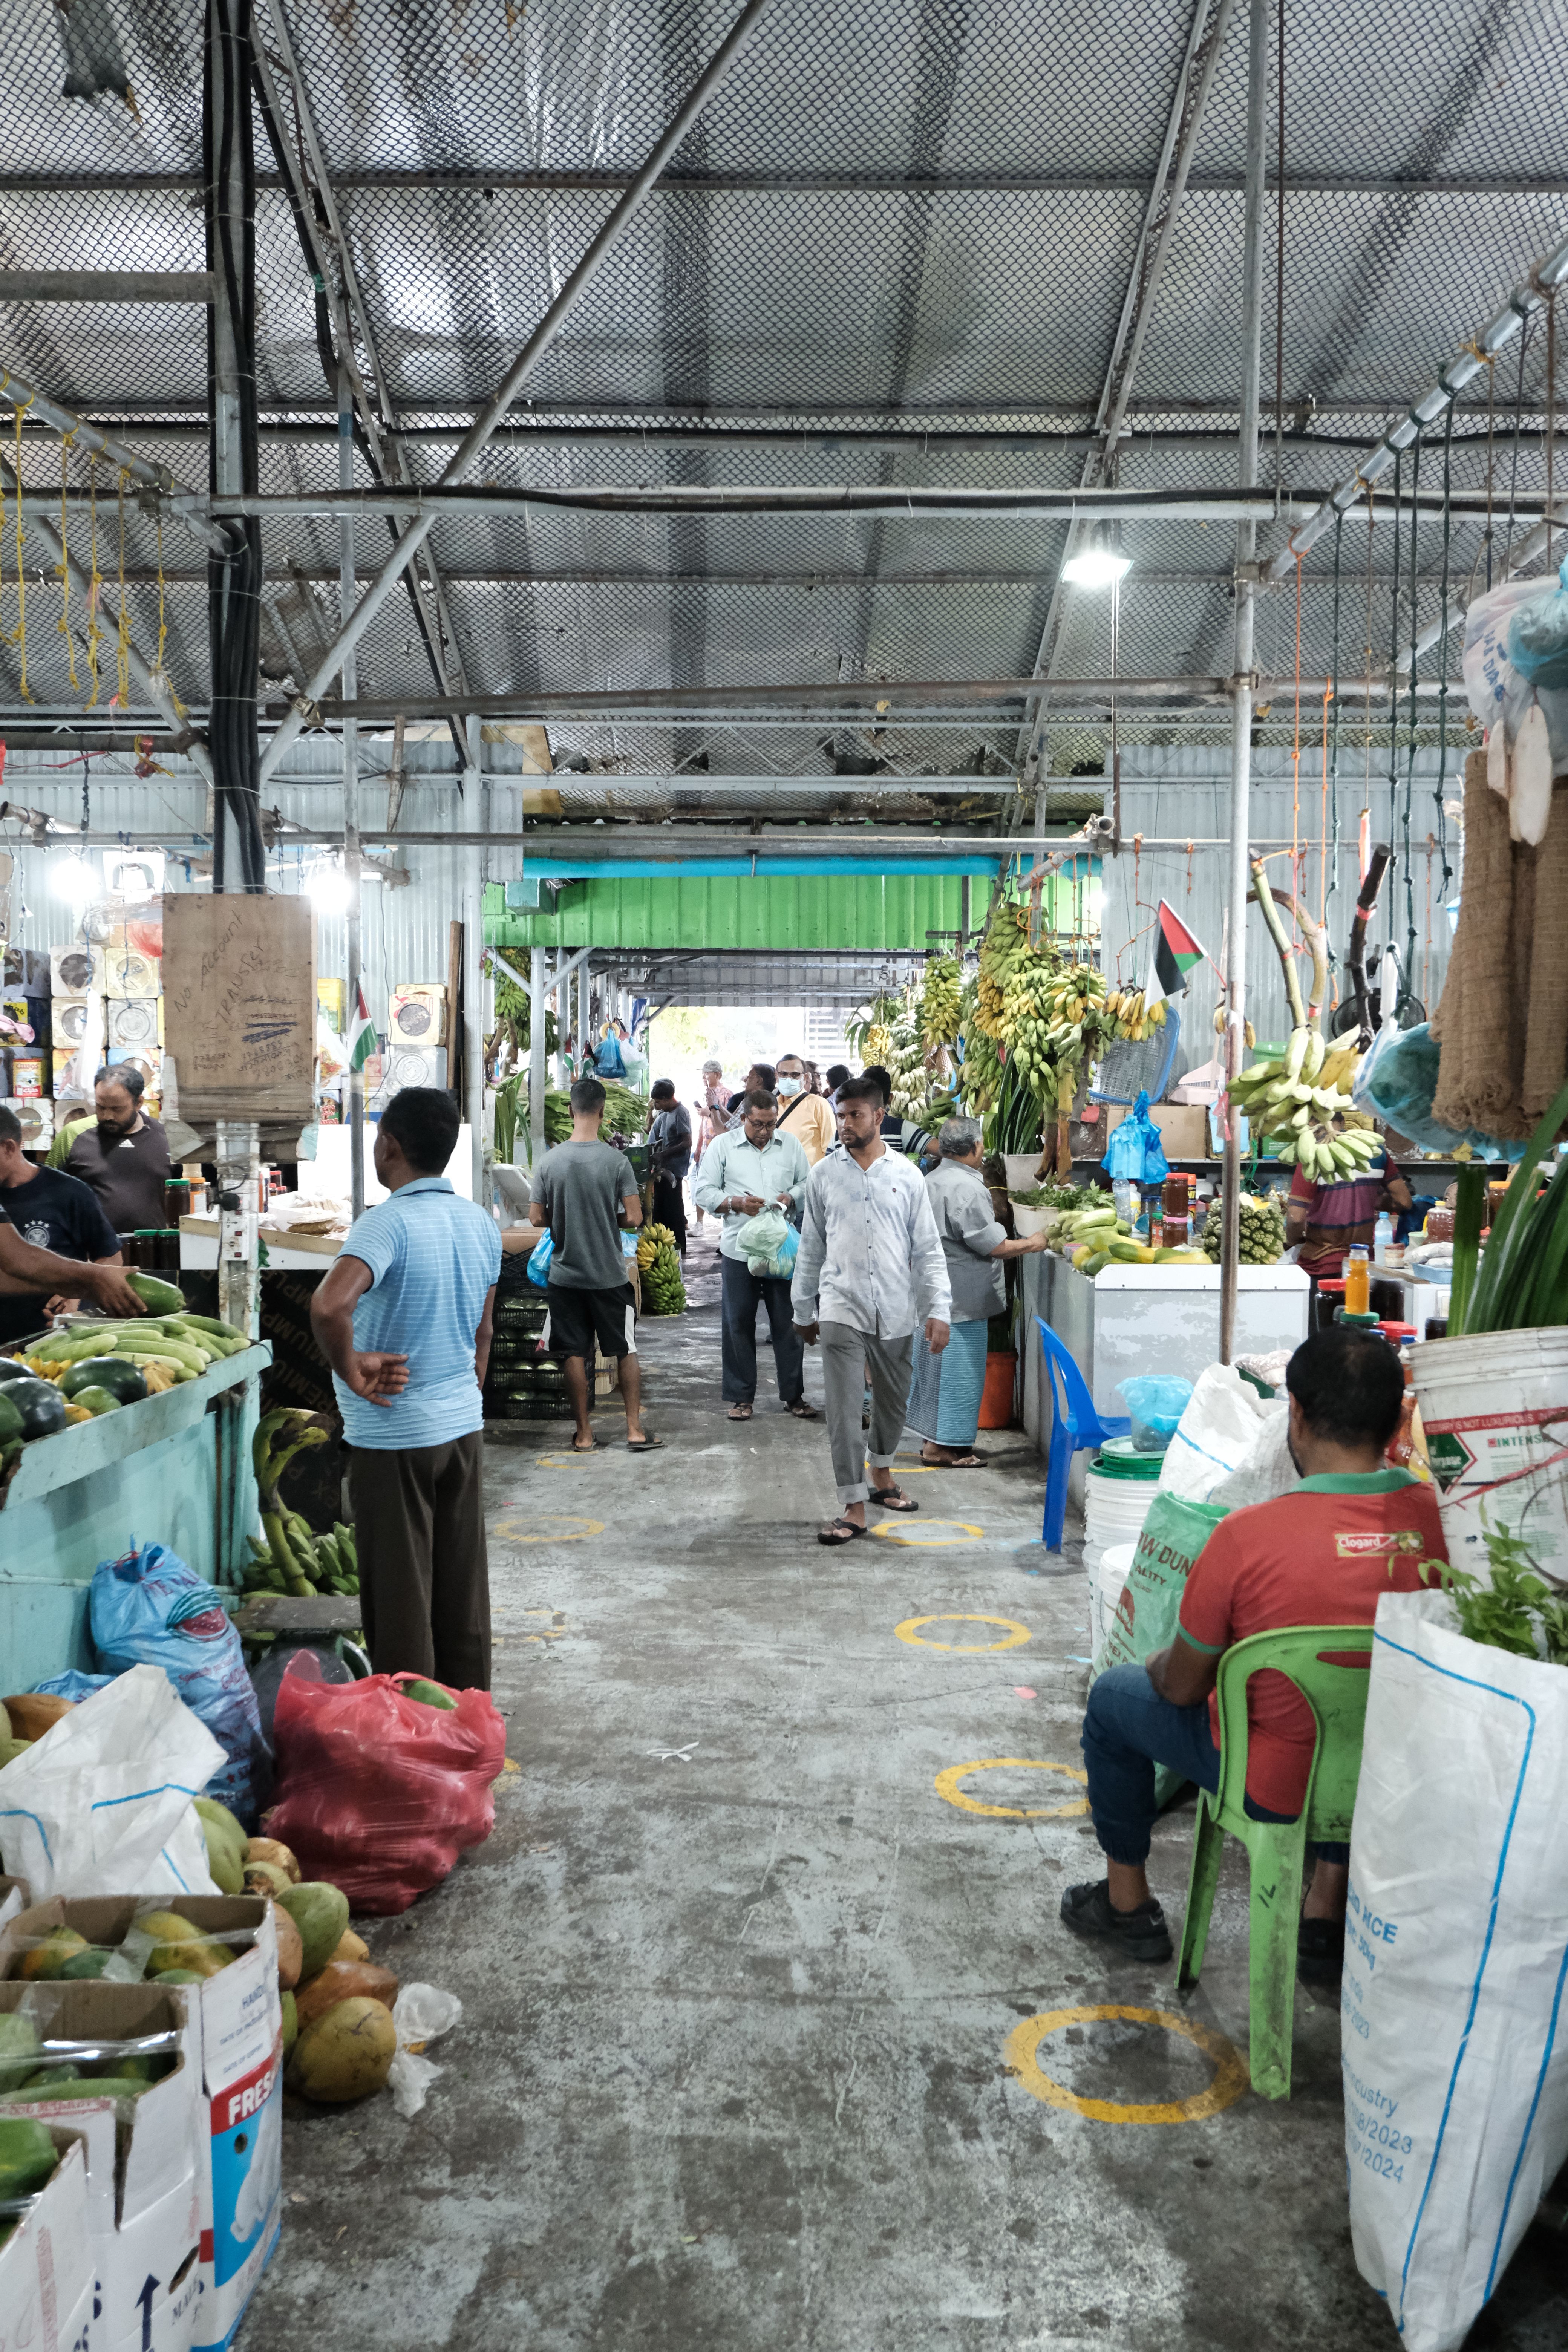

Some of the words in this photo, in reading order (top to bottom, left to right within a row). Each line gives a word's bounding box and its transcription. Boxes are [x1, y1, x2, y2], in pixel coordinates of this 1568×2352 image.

[173, 988, 191, 1012] No
[1338, 1536, 1381, 1549] Clogard
[1132, 1562, 1167, 1585] ALITY
[228, 2069, 274, 2127] FRES
